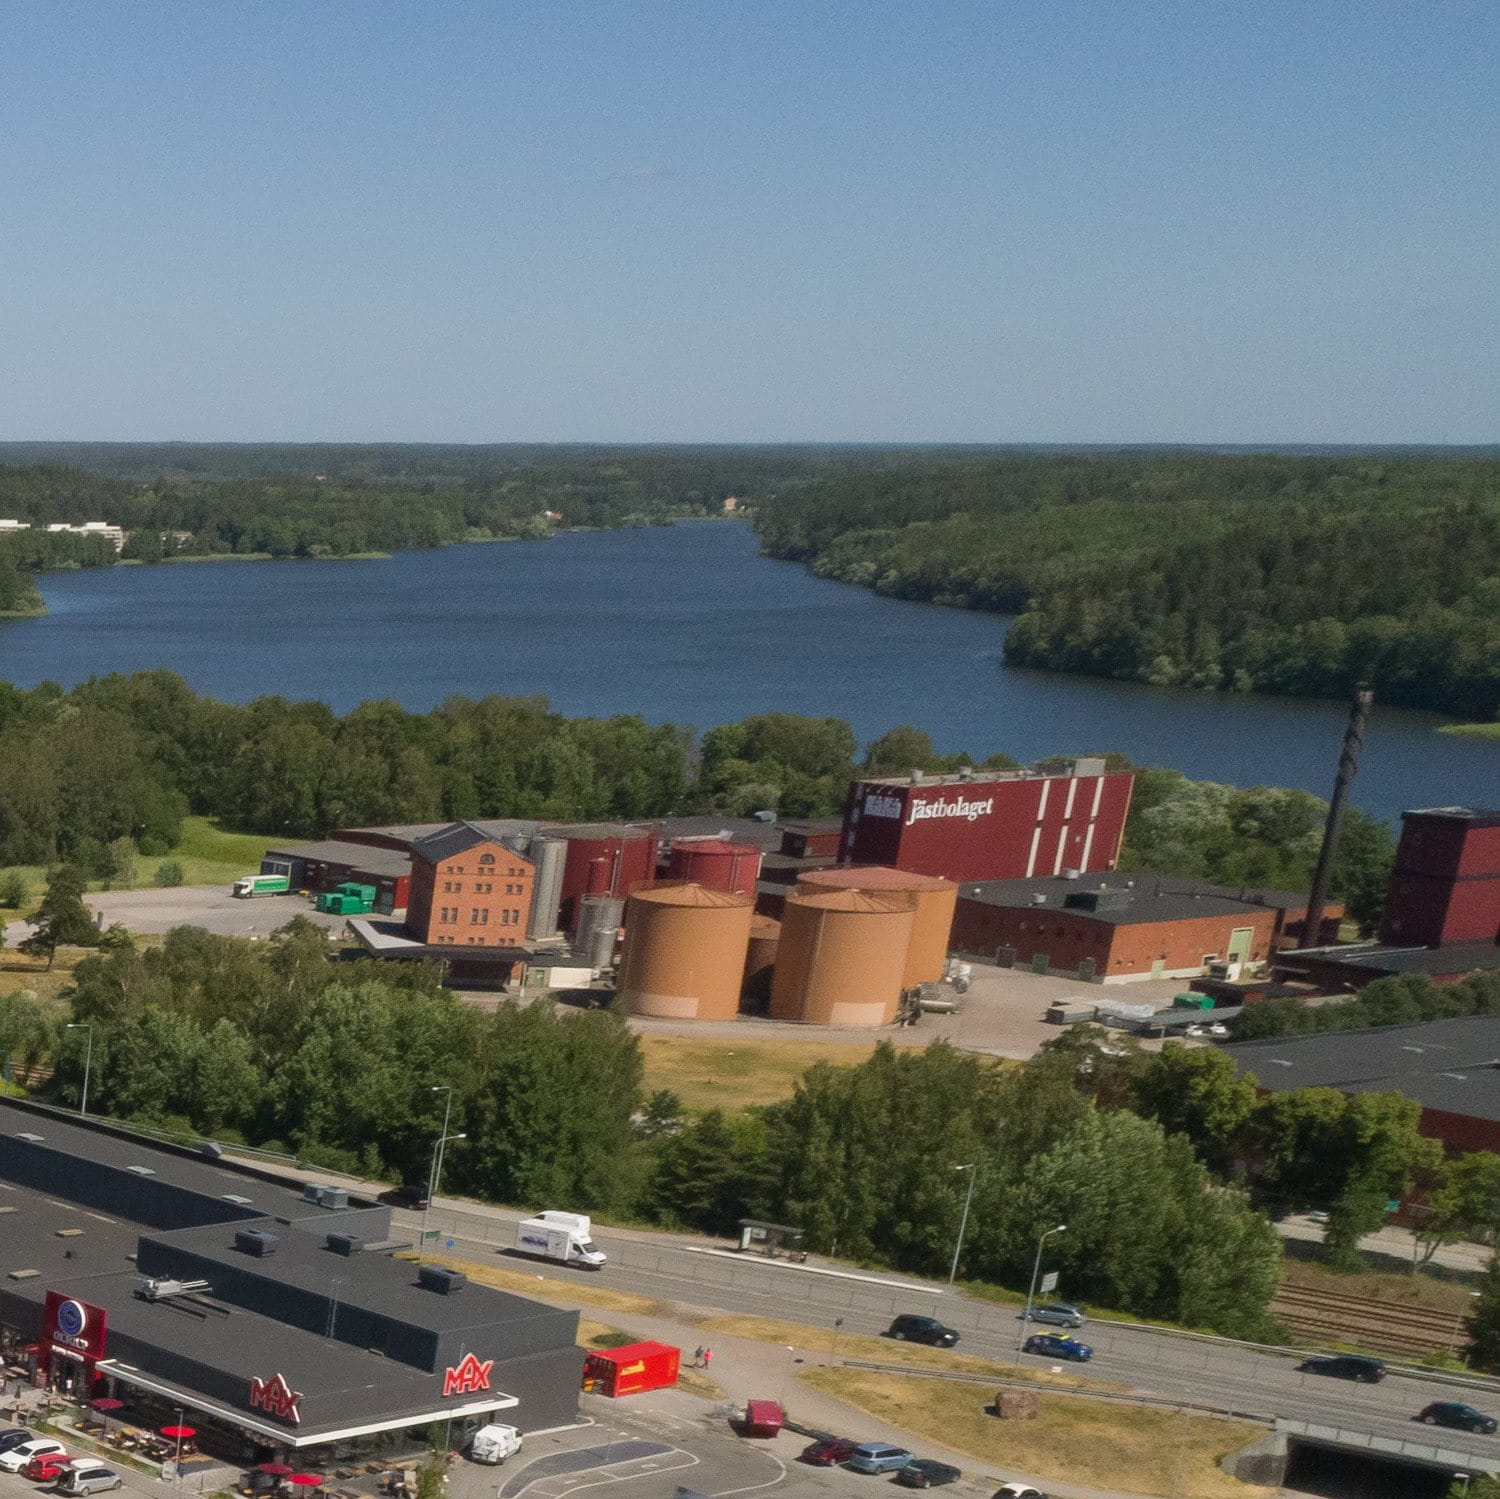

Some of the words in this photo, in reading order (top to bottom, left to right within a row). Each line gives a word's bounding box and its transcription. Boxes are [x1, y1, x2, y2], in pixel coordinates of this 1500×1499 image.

[906, 797, 994, 826] Jästbolaget
[442, 1352, 494, 1397] MAX
[250, 1373, 300, 1423] MAX
